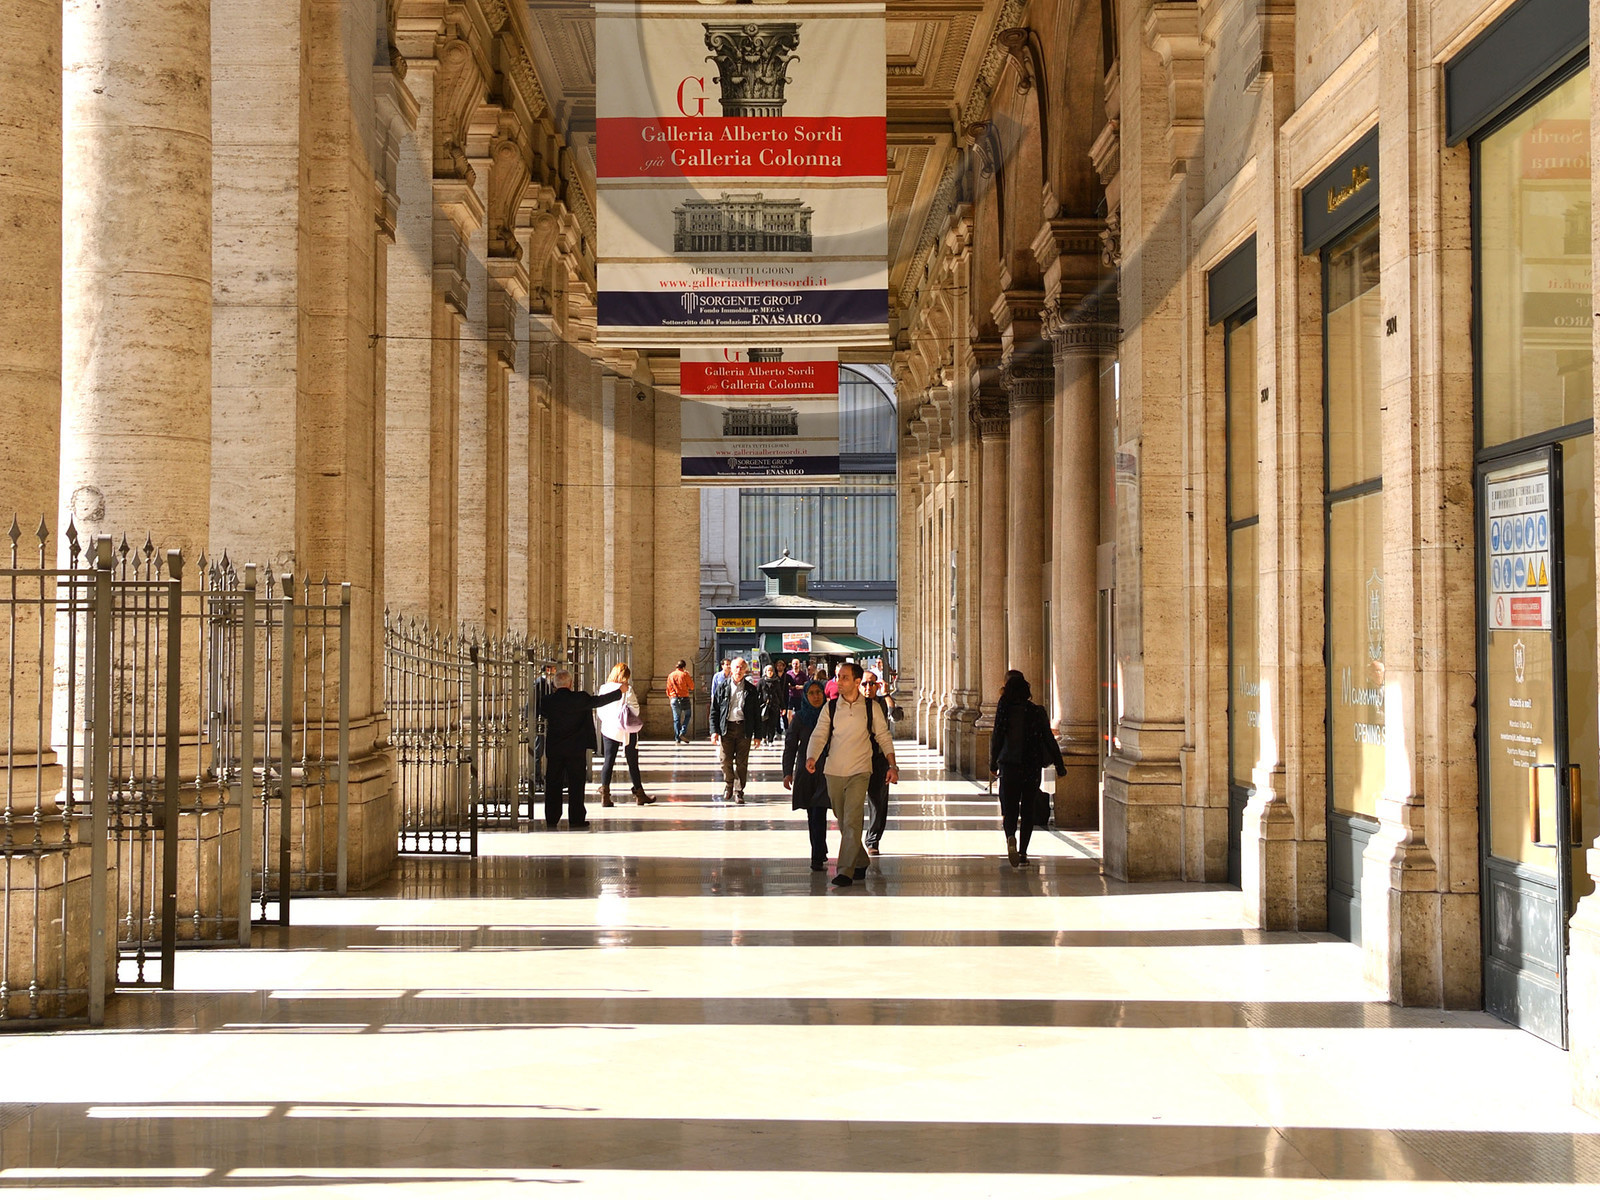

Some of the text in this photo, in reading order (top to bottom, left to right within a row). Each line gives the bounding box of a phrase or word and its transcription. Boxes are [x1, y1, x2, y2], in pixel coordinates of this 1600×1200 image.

[677, 75, 710, 117] G
[641, 125, 843, 142] Galleria Alberto Sordi
[671, 148, 752, 166] Galleria
[759, 148, 842, 166] Colonna
[689, 267, 724, 275] APERTA
[726, 267, 754, 275] TUTTI
[660, 276, 827, 290] www.galleriaalbertosordi.it
[700, 295, 803, 306] SORGENTE GROUP
[752, 314, 822, 325] ENASARCO
[704, 366, 814, 376] Galleria Alberto Sordi
[721, 379, 765, 390] Galleria
[769, 379, 814, 389] Colonna
